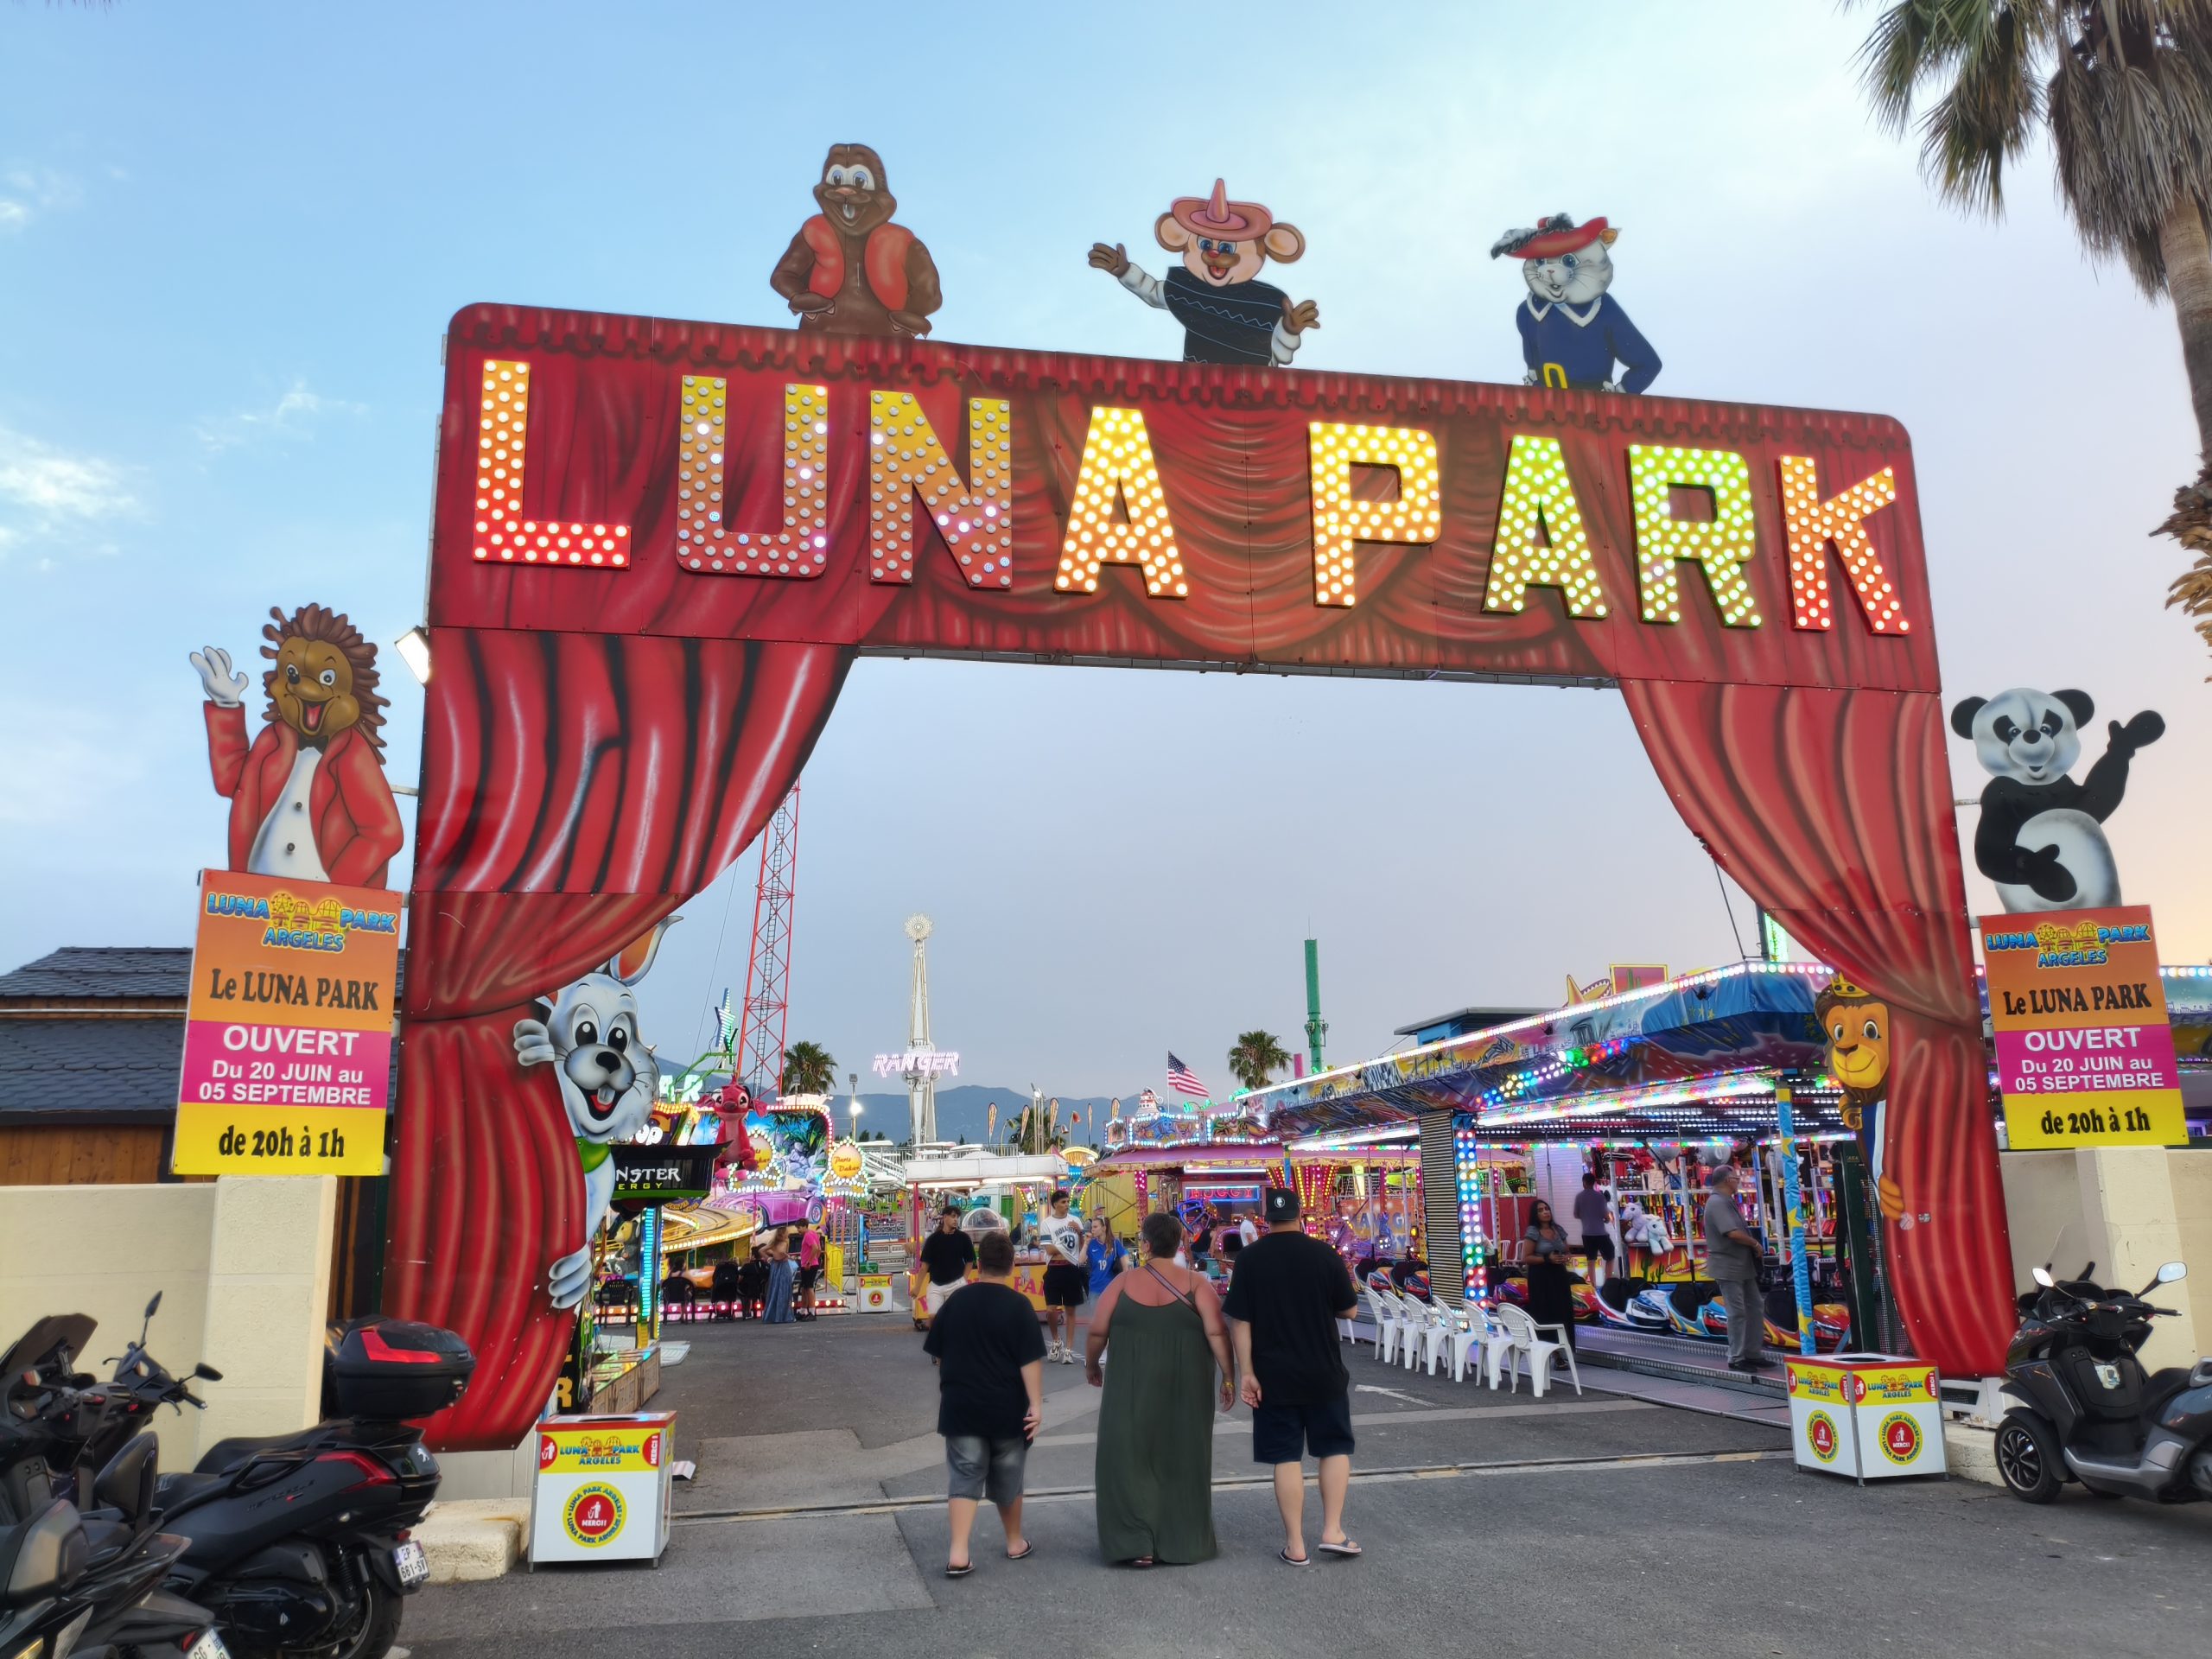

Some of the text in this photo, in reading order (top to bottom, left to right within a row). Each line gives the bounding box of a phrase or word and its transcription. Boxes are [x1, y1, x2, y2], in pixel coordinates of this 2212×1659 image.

[472, 358, 1910, 635] LUNA PARK
[206, 893, 397, 935] LUNA PARK
[262, 927, 345, 953] ARGELES
[1986, 924, 2152, 951] LUNA PARK
[2037, 950, 2108, 969] ARGELES
[209, 968, 379, 1011] Le LUNA PARK
[2003, 983, 2152, 1016] Le LUNA PARK
[222, 1025, 359, 1056] OUVERT
[2024, 1027, 2142, 1052] OUVERT
[212, 1059, 364, 1084] Du 20 JUIN au
[872, 1052, 960, 1078] RANGER
[2021, 1056, 2153, 1075] Du 20 JUIN au
[199, 1082, 372, 1106] 05 SEPTEMBRE
[2015, 1072, 2165, 1092] 05 SEPTEMBRE
[2041, 1106, 2152, 1135] de 20h à 1h
[218, 1125, 346, 1159] de 20h à 1h
[1098, 1259, 1108, 1271] 19
[559, 1445, 639, 1455] LUNA PARK
[579, 1456, 621, 1465] ARGELES
[583, 1486, 602, 1495] PARK
